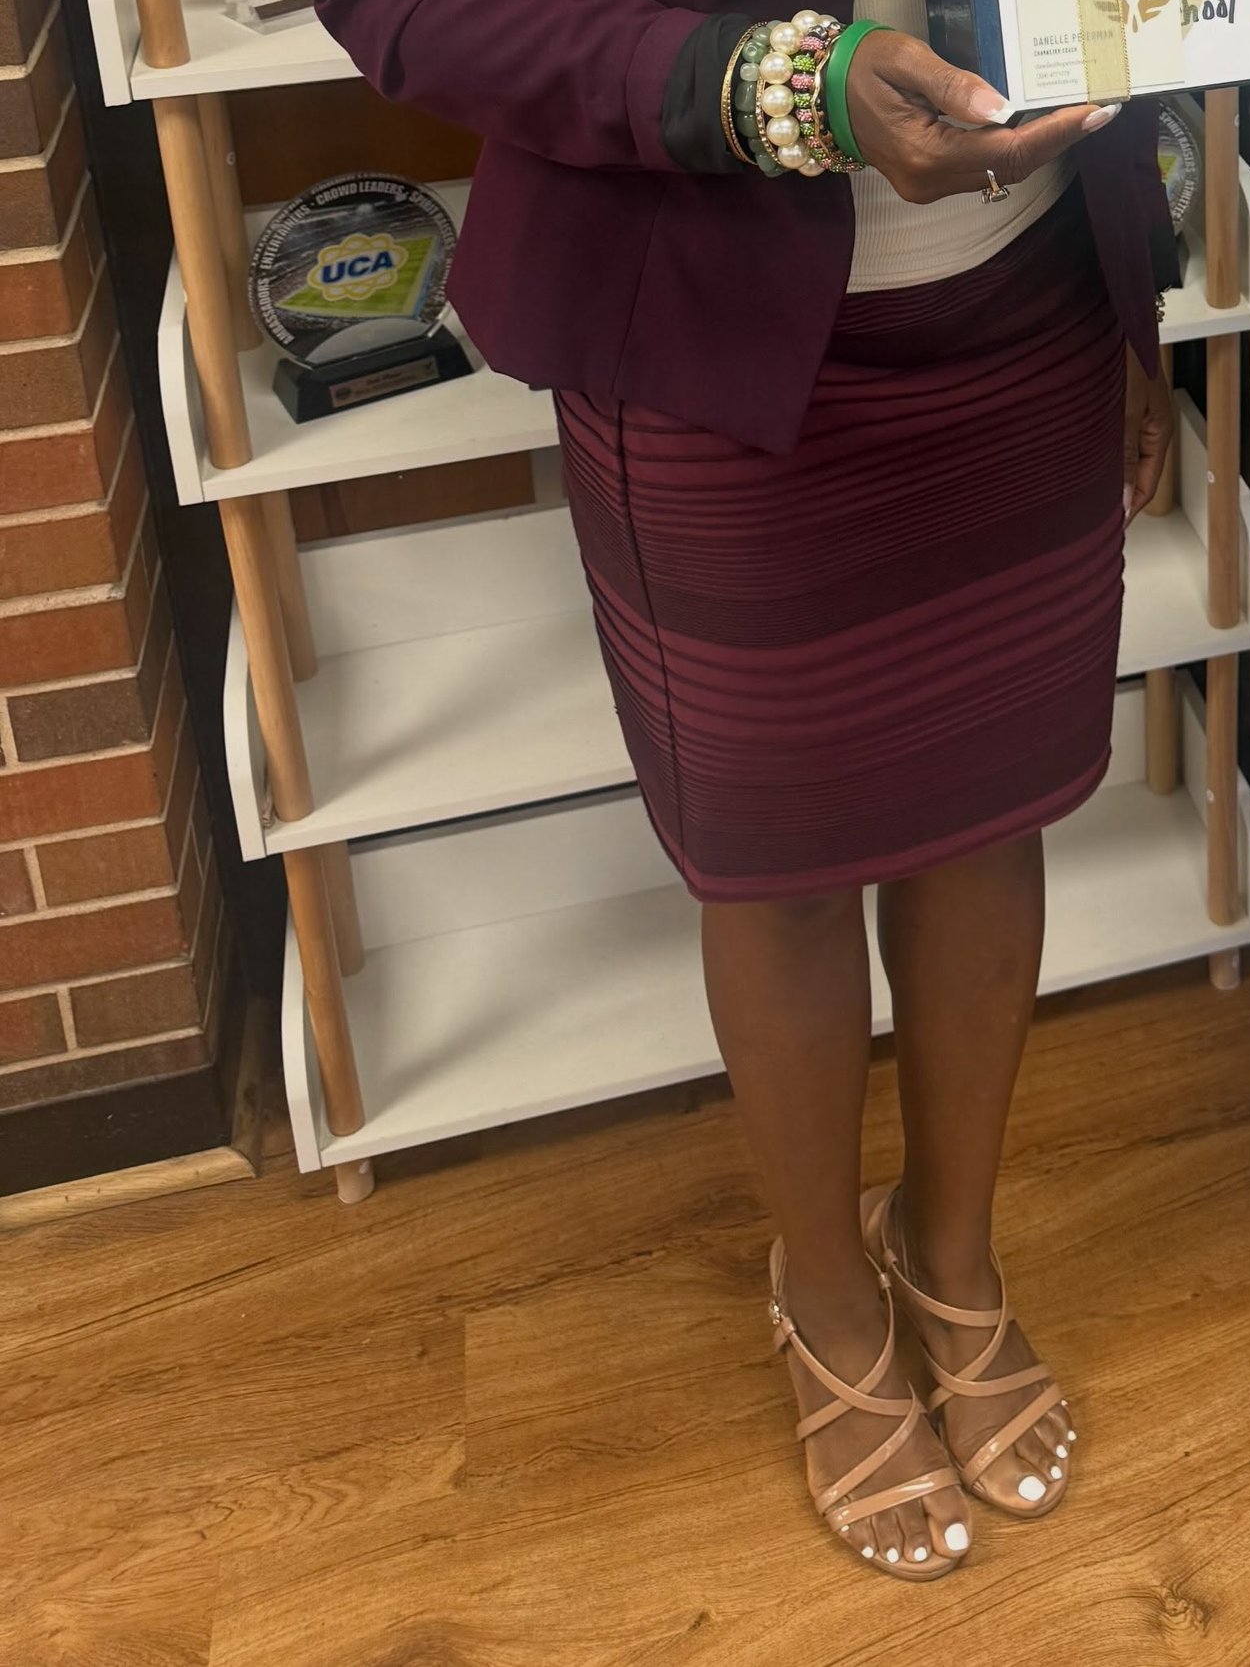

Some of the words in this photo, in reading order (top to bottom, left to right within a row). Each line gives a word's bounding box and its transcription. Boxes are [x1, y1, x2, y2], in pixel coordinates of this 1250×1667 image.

[1033, 33, 1069, 47] DANELLE
[315, 184, 358, 205] CROWD
[359, 180, 406, 195] LEADERS
[264, 204, 312, 270] ENTERTAINERS
[321, 251, 394, 283] UCA
[257, 277, 295, 345] AMBASSADORS
